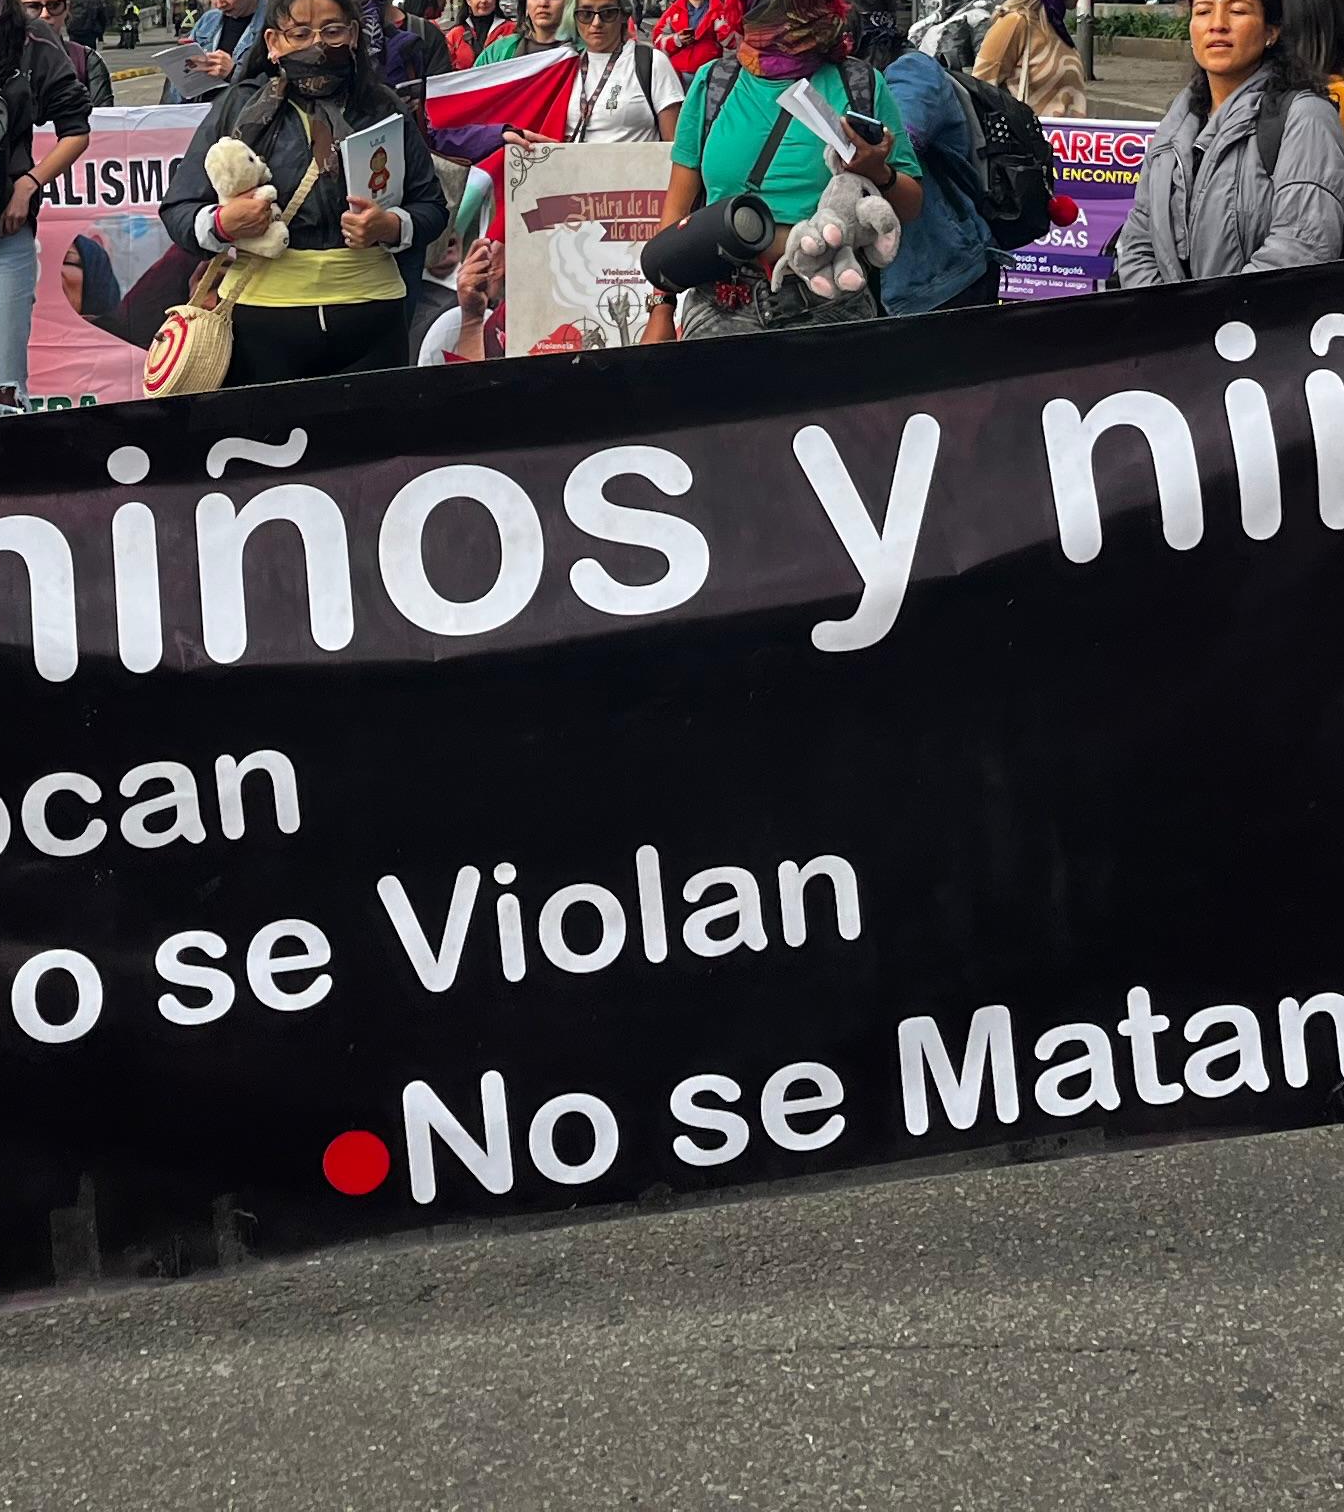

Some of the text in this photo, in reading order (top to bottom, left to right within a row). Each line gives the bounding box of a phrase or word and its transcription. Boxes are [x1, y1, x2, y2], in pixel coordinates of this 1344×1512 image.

[1042, 130, 1156, 167] AREC
[568, 192, 660, 225] Hidra de la
[602, 268, 641, 276] Violencia
[1016, 262, 1037, 272] 2023
[793, 413, 940, 652] y
[155, 919, 333, 1026] se
[377, 845, 862, 993] Violan
[403, 1070, 619, 1205] No
[670, 1061, 846, 1167] se
